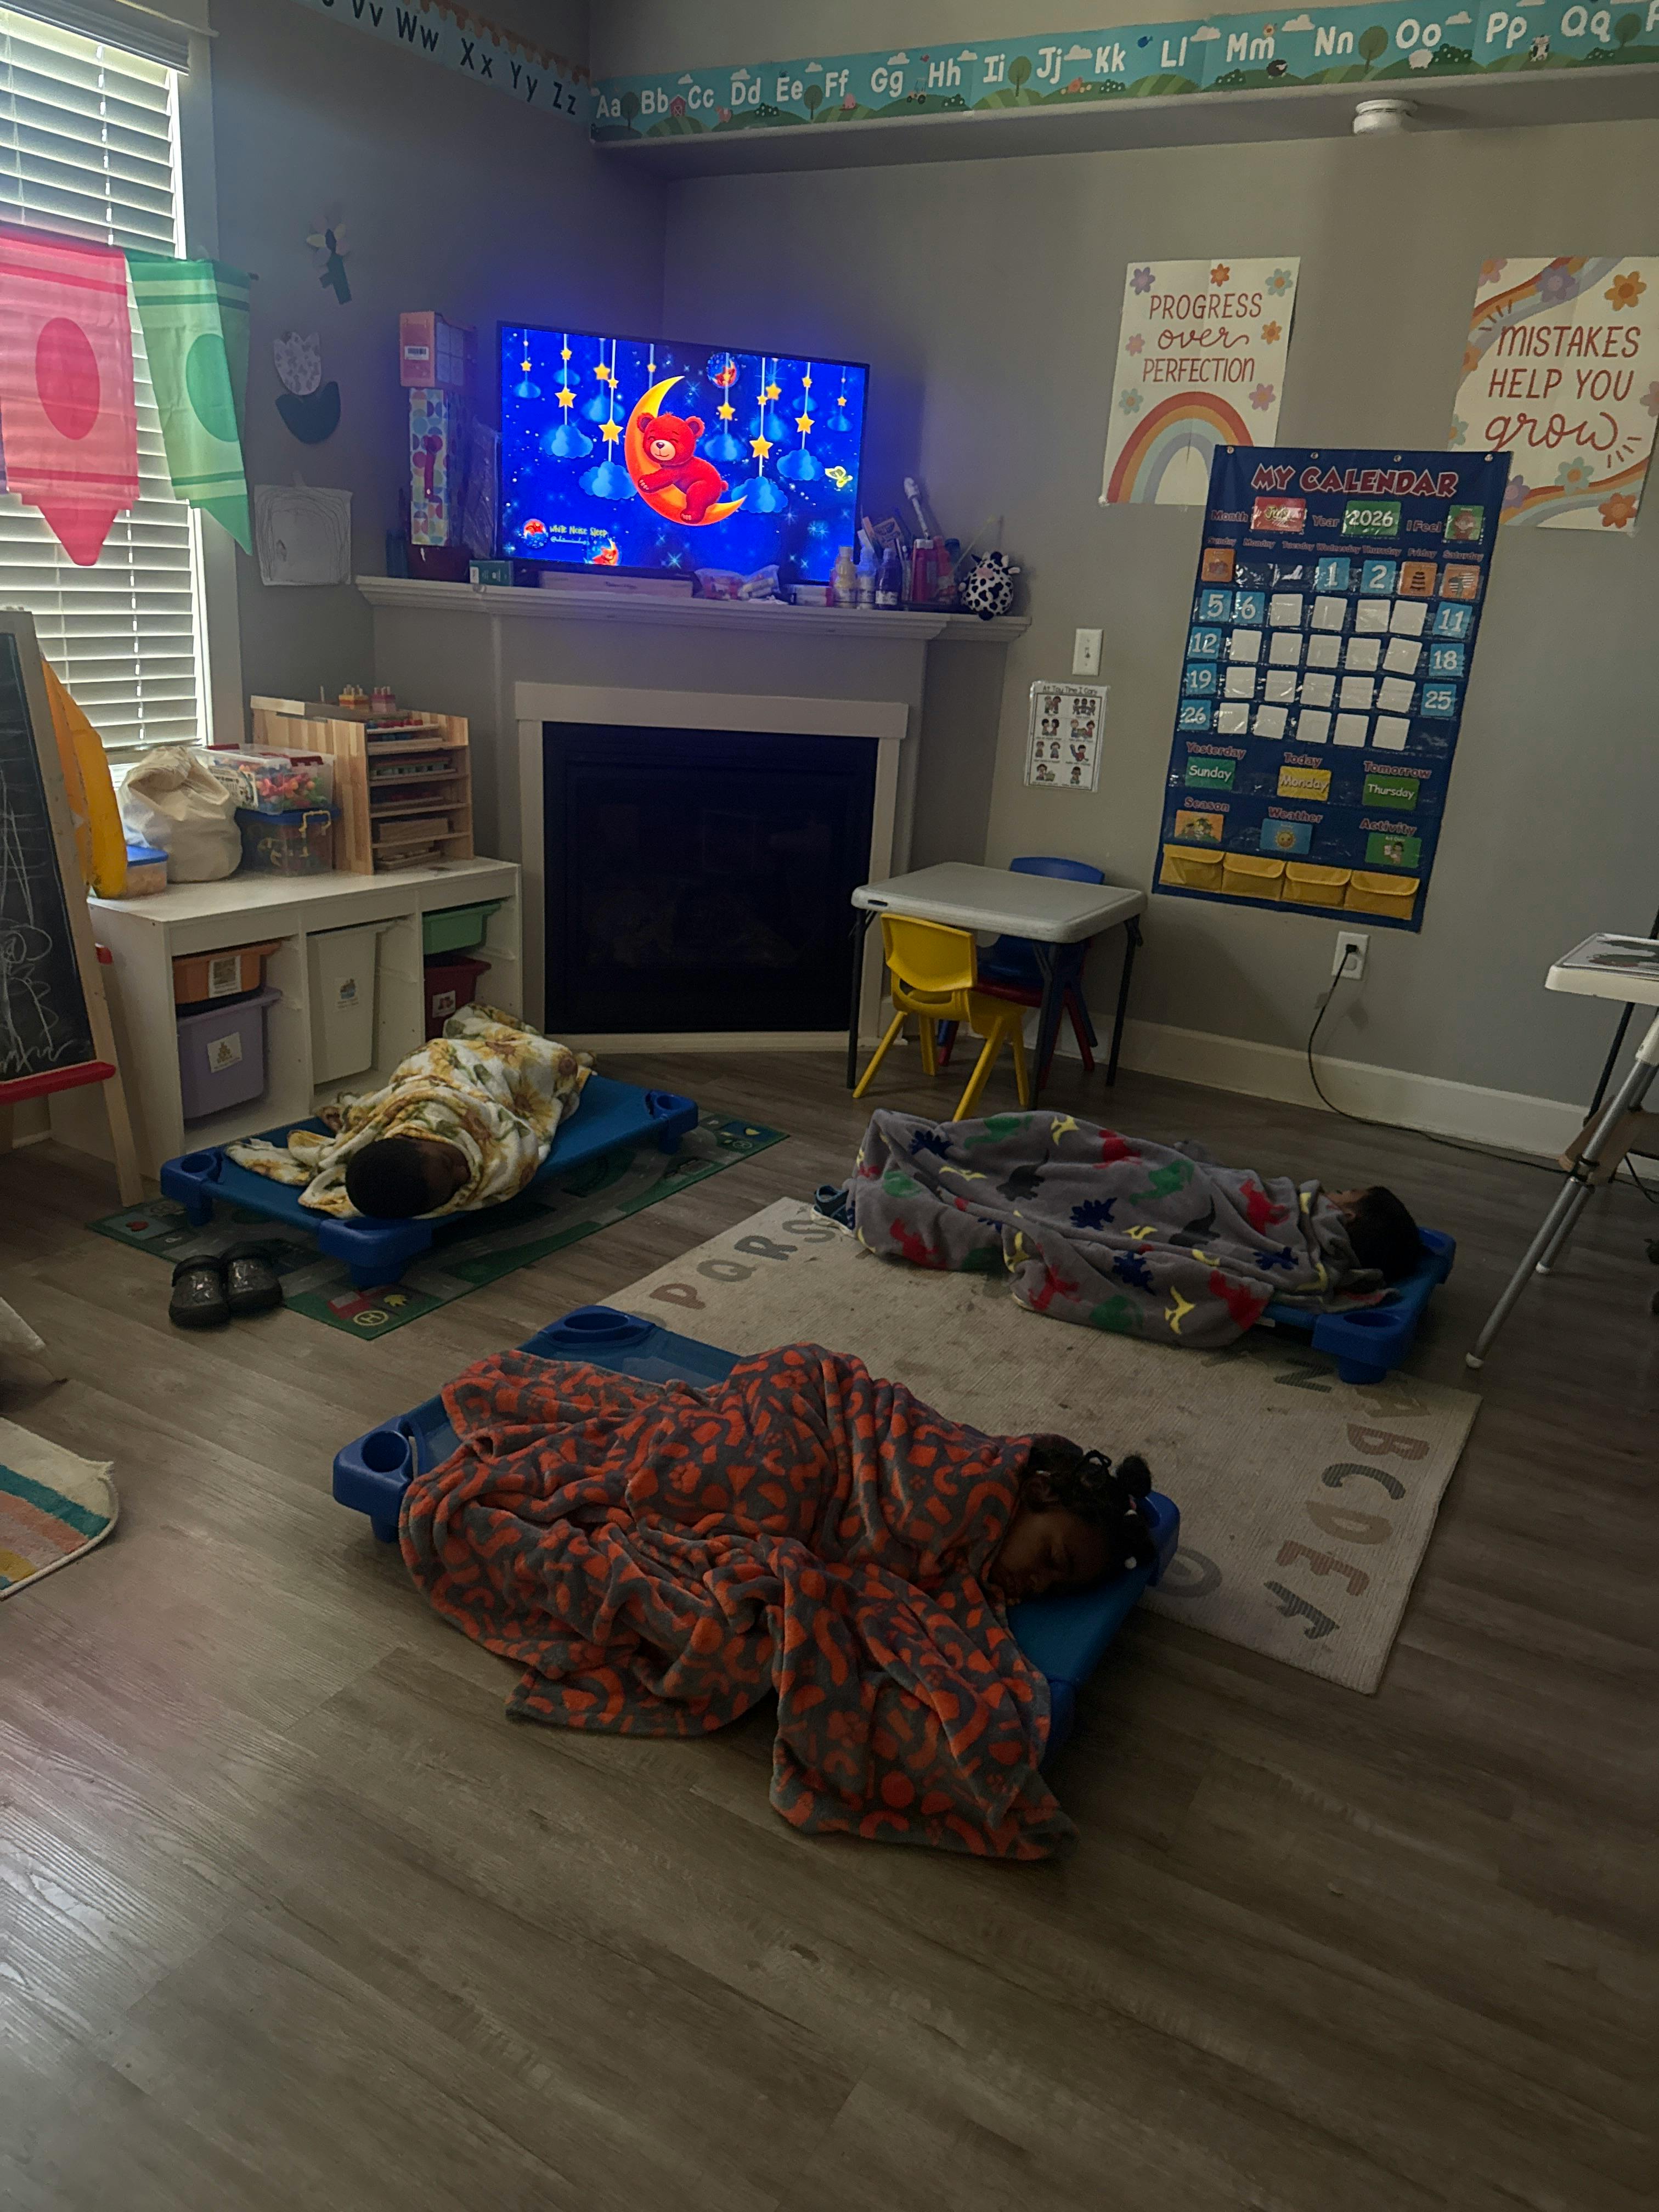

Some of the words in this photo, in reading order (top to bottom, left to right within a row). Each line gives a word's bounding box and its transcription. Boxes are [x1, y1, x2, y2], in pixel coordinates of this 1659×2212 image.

[396, 8, 438, 52] Ww
[460, 38, 493, 78] Xx
[510, 60, 538, 102] Yy
[553, 81, 576, 115] Zz
[596, 95, 622, 119] Aa
[640, 87, 669, 115] Bb
[688, 85, 714, 109] Cc
[731, 78, 761, 106] Dd
[776, 76, 803, 103] Ee
[825, 69, 849, 98] Ff
[871, 67, 904, 98] Gg
[928, 58, 961, 88] Hh
[983, 54, 1006, 83] Ii
[1036, 47, 1063, 84] Jj
[1095, 43, 1125, 74] Kk
[1161, 36, 1188, 67] Ll
[1226, 32, 1275, 62] Mm
[1315, 27, 1353, 57] Nn
[1396, 18, 1442, 49] Oo
[1486, 12, 1527, 49] Pp
[1561, 6, 1611, 43] Qq
[1149, 292, 1262, 320] PROGRESS
[1158, 327, 1249, 349] over
[1497, 326, 1641, 358] MISTAKES
[1143, 357, 1255, 382] PERFECTION
[1488, 368, 1562, 399] HELP
[1576, 369, 1634, 402] YOU
[1485, 412, 1618, 452] grow
[1251, 464, 1296, 492] MY
[1300, 466, 1459, 498] CALENDAR
[1211, 510, 1249, 523] Month
[1312, 515, 1340, 527] Year
[1348, 510, 1393, 527] 2026
[569, 526, 588, 535] Noise
[590, 527, 608, 538] Sleep
[1406, 520, 1412, 532] I
[1413, 520, 1443, 533] Feel
[1243, 538, 1276, 549] Monday
[1282, 540, 1315, 551] Tuesday
[1362, 545, 1402, 557] Thursday
[1408, 548, 1437, 558] Friday
[1442, 550, 1484, 562] Saturday
[1326, 561, 1338, 587] 1
[1369, 565, 1387, 589] 2
[1207, 594, 1224, 618] 5
[1239, 595, 1256, 619] 6
[1438, 608, 1464, 632] 11
[1192, 632, 1217, 653] 12
[1432, 650, 1458, 670] 18
[1190, 670, 1212, 689] 19
[1425, 690, 1452, 710] 25
[1182, 707, 1206, 725] 26
[1186, 742, 1247, 760] Yesterday
[1284, 752, 1323, 768] Today
[1189, 765, 1232, 782] Sunday
[1363, 760, 1432, 779] Tomorrow
[1280, 776, 1329, 793] Monday
[1368, 783, 1414, 800] Thursday
[1184, 796, 1230, 812] Season
[1268, 806, 1324, 823] Weather
[1359, 818, 1417, 837] Activity
